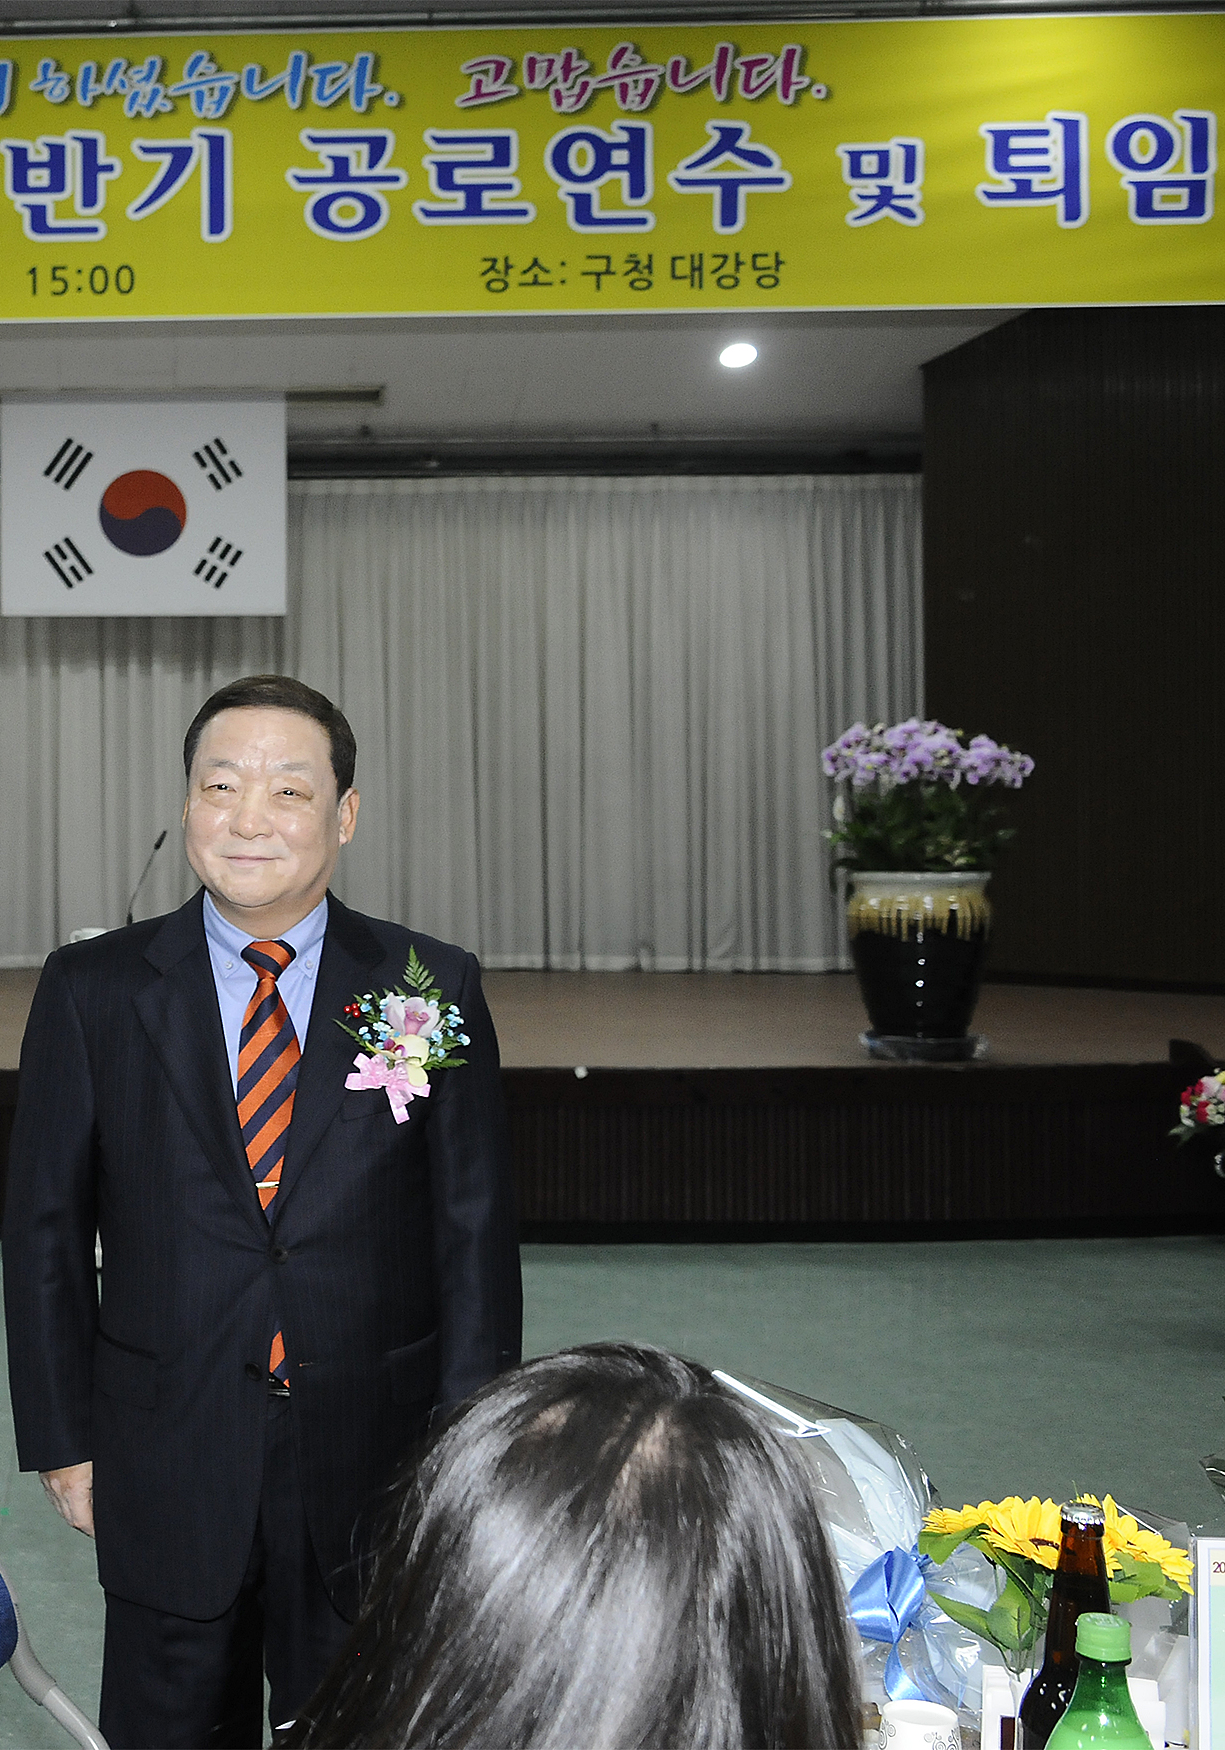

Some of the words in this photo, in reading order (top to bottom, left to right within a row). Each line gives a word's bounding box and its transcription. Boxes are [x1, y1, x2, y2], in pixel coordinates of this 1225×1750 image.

[31, 52, 400, 117] 하셨습니다.
[460, 45, 827, 110] 고맙습니다.
[289, 122, 789, 237] 공로연수
[840, 140, 922, 223] 및
[978, 113, 1214, 225] 퇴임
[27, 264, 136, 298] 15:00
[479, 254, 567, 294] 장소:
[580, 252, 655, 292] 구청
[669, 250, 786, 291] 대강당
